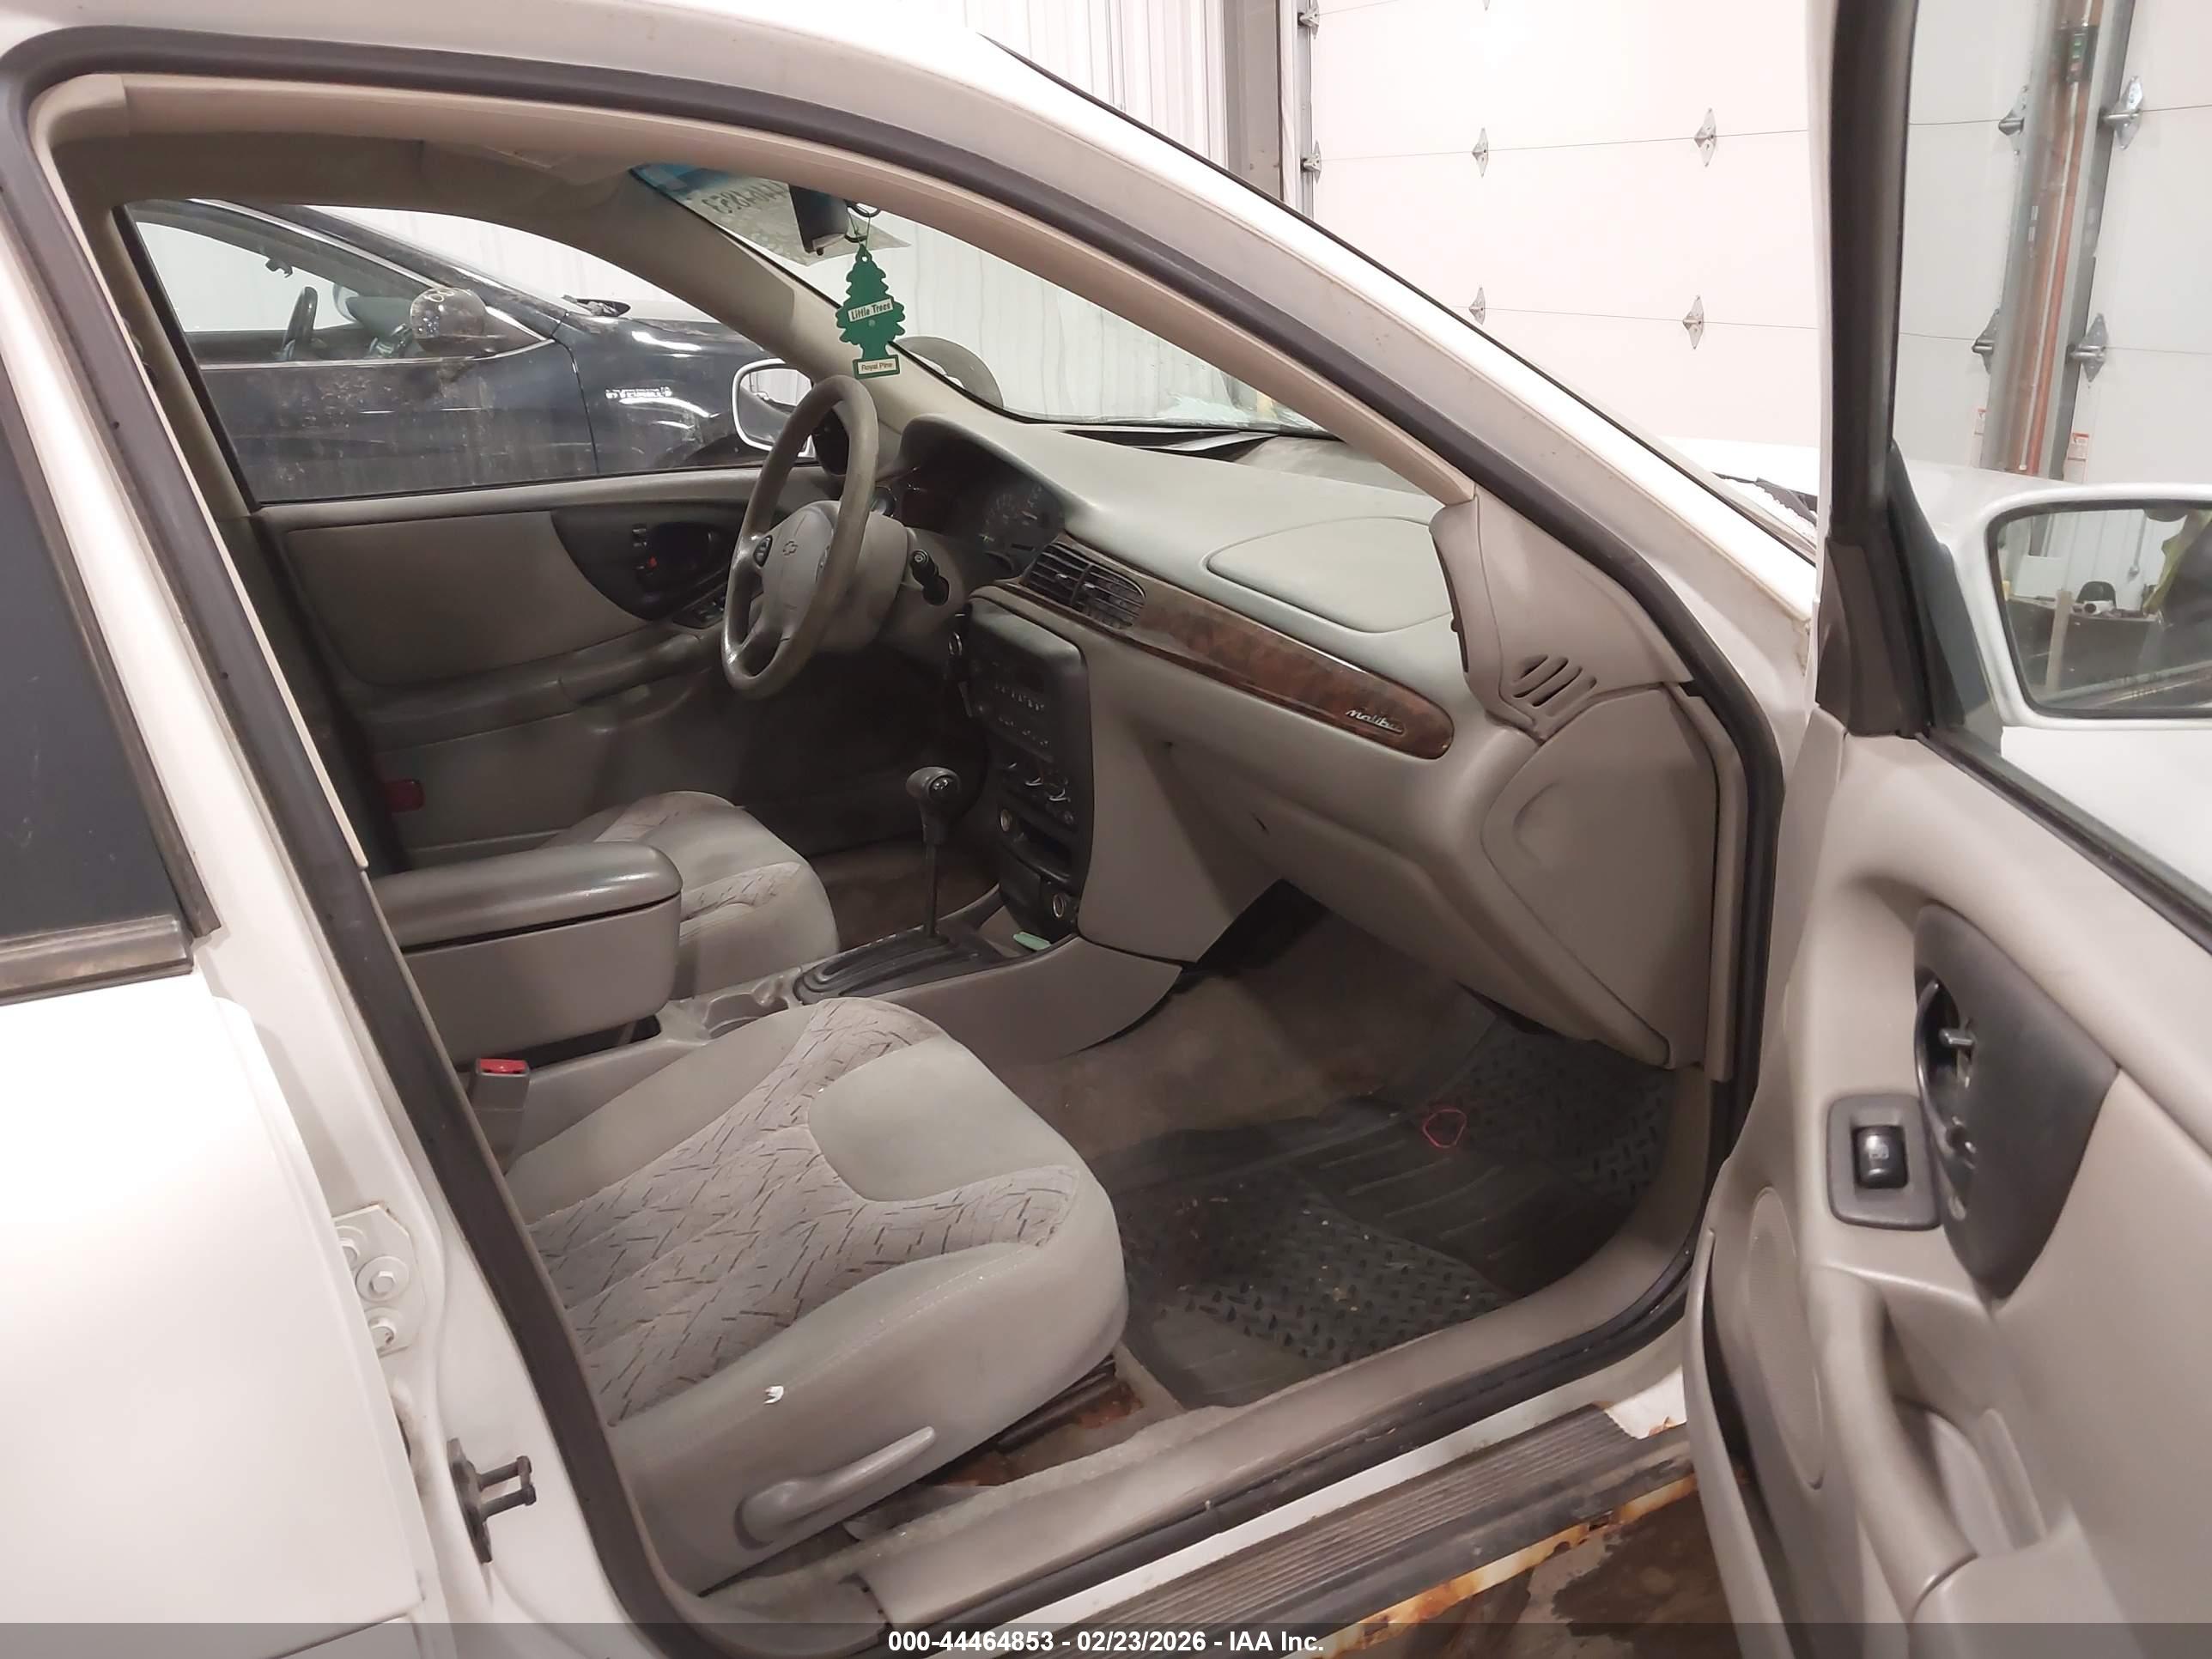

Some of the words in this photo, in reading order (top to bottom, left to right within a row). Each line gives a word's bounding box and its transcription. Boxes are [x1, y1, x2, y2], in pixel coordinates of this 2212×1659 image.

[851, 307, 871, 320] Little
[872, 302, 890, 313] Trees
[861, 362, 878, 372] Royal
